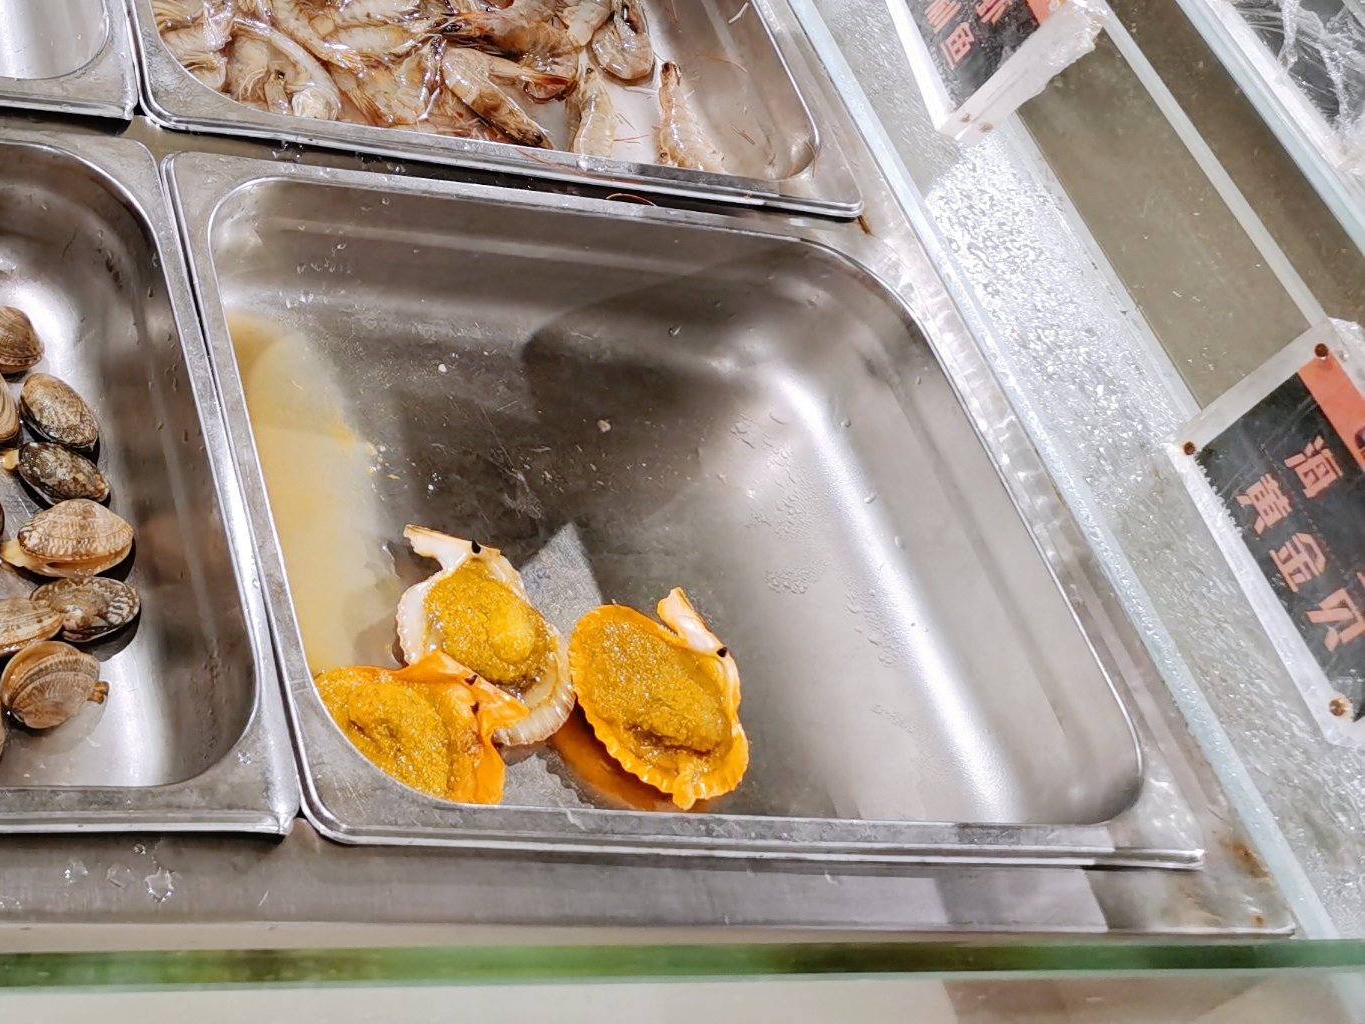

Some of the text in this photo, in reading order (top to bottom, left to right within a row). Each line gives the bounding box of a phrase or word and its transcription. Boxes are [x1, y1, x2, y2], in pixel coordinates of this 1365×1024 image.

[1284, 434, 1343, 500] 海
[1236, 473, 1365, 652] 黄金贝
